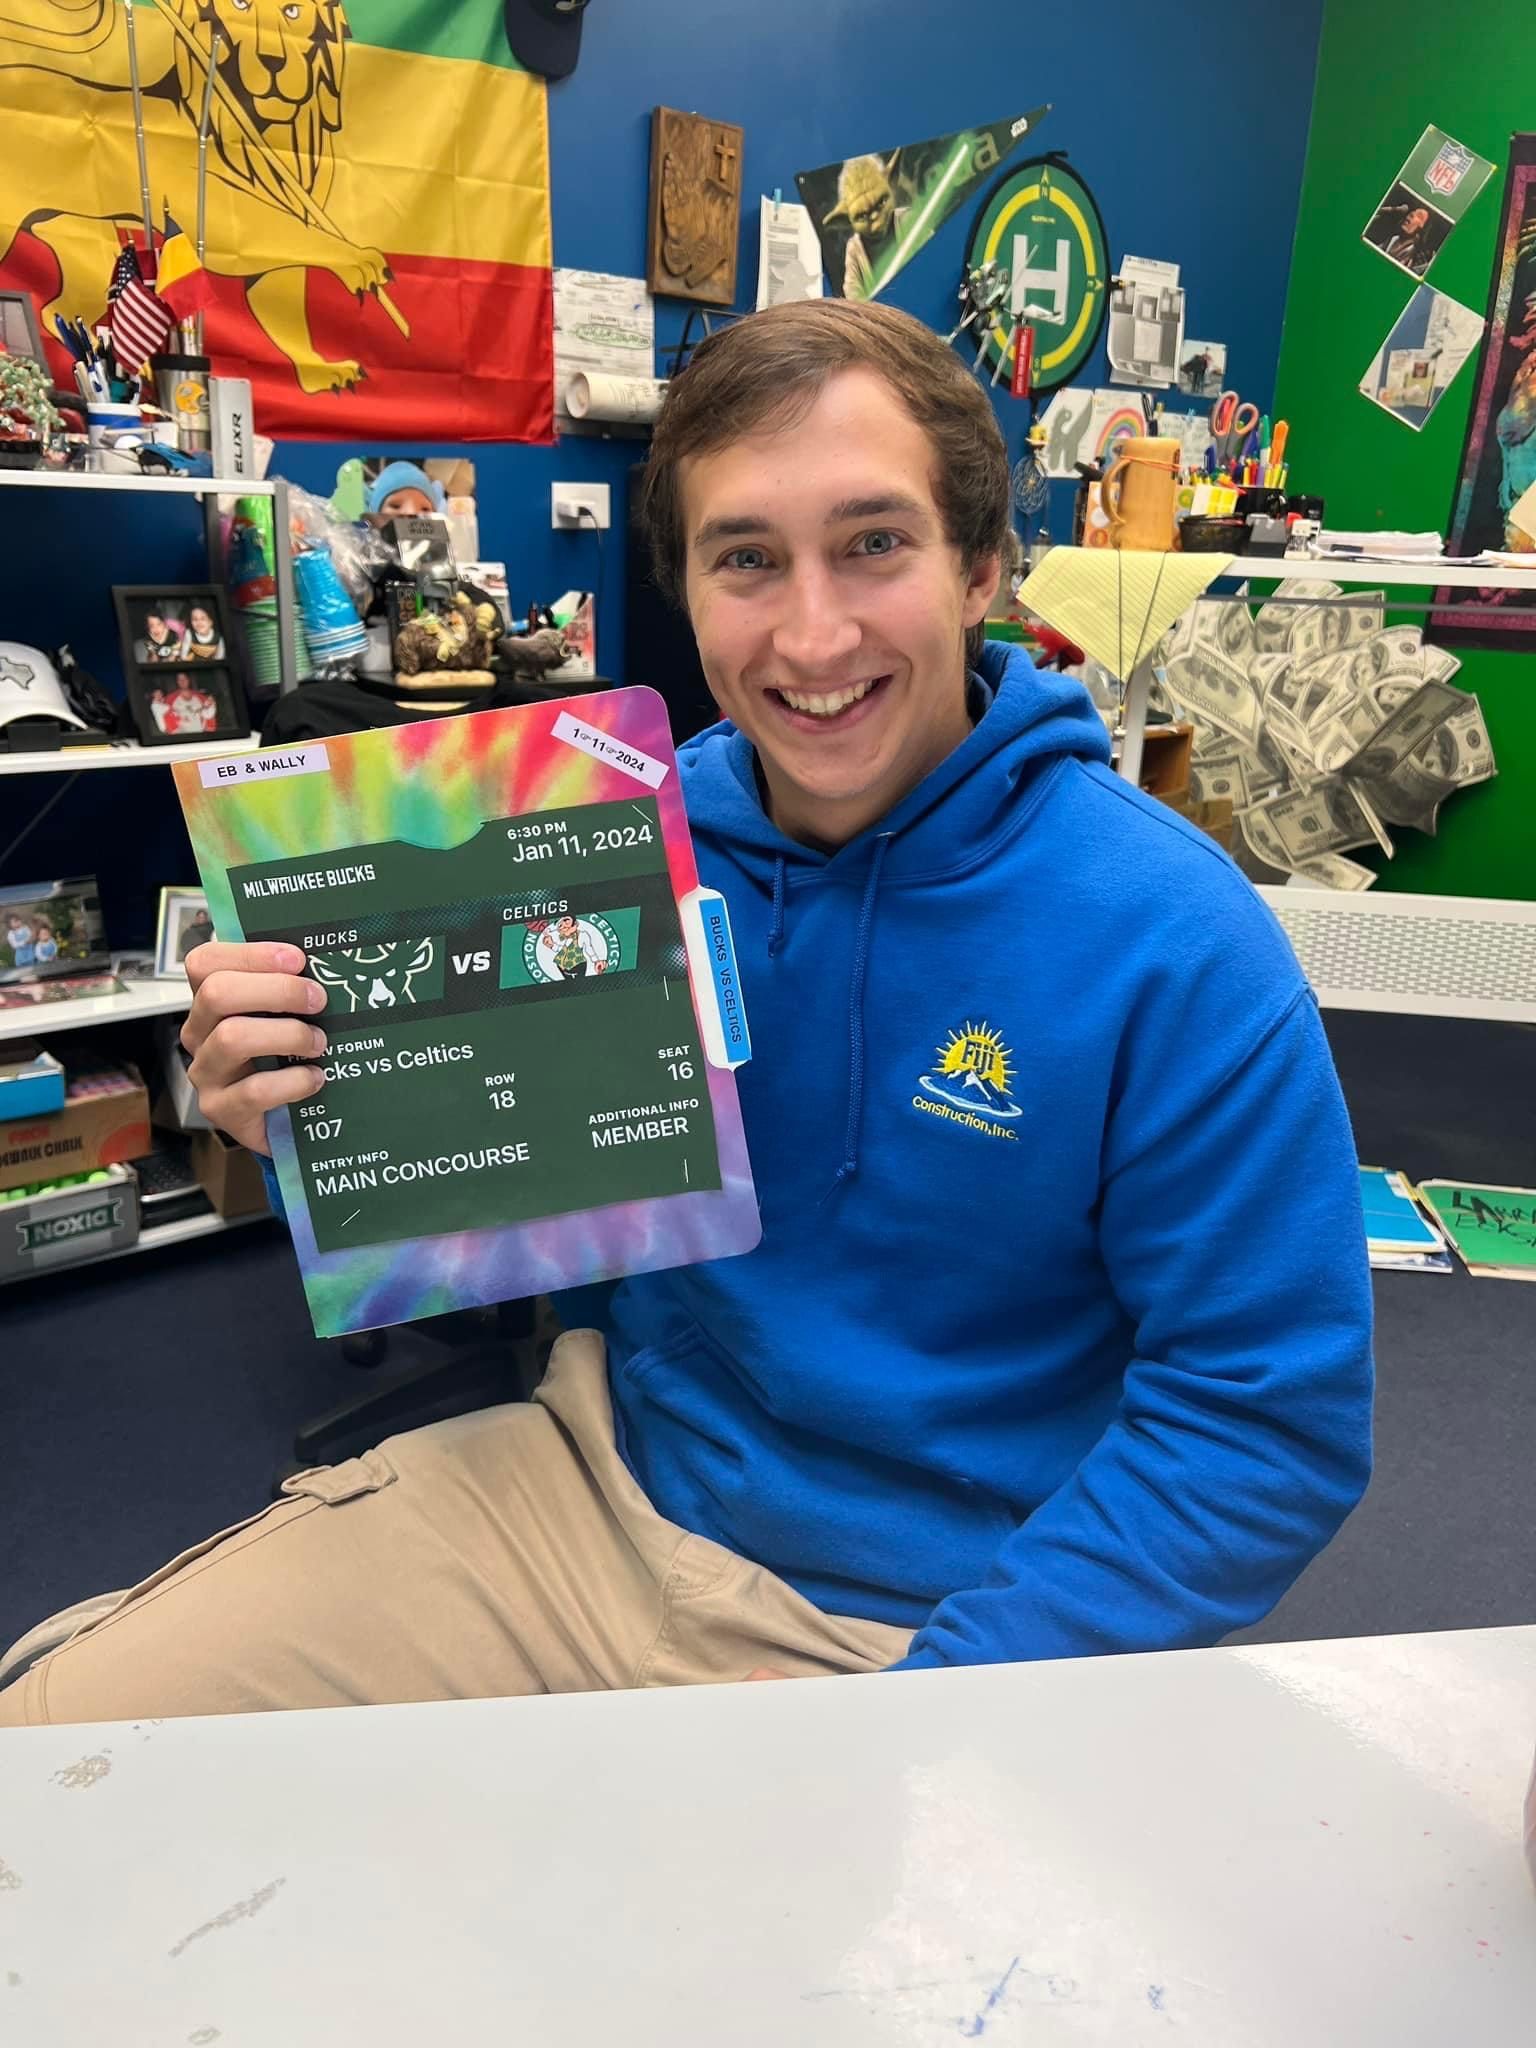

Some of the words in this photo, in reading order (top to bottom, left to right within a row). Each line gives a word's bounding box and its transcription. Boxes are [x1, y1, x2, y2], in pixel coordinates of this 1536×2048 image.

[1429, 161, 1456, 190] NFL
[1011, 234, 1070, 325] H
[232, 412, 243, 474] ELIXR
[217, 765, 237, 778] EB
[246, 763, 256, 773] &
[259, 755, 306, 772] WALLY
[507, 824, 542, 840] 6:30
[545, 821, 567, 834] PM
[512, 840, 553, 863] Jan
[557, 835, 587, 857] 11,
[592, 825, 654, 851] 2024
[243, 871, 326, 899] MILWAUKEE
[327, 864, 376, 886] BUCKS
[503, 900, 568, 921] CELTICS
[304, 930, 358, 948] BUCKS
[589, 913, 620, 967] CELTICS
[710, 915, 727, 962] BUCKS
[720, 968, 732, 986] VS
[724, 989, 742, 1043] CELTICS
[337, 1038, 385, 1054] FORUM
[657, 1045, 690, 1059] SEAT
[324, 1060, 361, 1081] cks
[366, 1057, 393, 1075] vs
[397, 1046, 474, 1070] Celtics
[667, 1062, 694, 1081] 16
[485, 1072, 515, 1087] ROW
[299, 1105, 326, 1118] SEC
[488, 1090, 516, 1110] 18
[588, 1104, 667, 1125] ADDITIONAL
[669, 1098, 699, 1112] INFO
[303, 1119, 343, 1142] 107
[591, 1117, 689, 1148] MEMBER
[311, 1156, 355, 1172] ENTRY
[358, 1150, 389, 1164] INFO
[315, 1169, 377, 1197] MAIN
[382, 1142, 530, 1185] CONCOURSE
